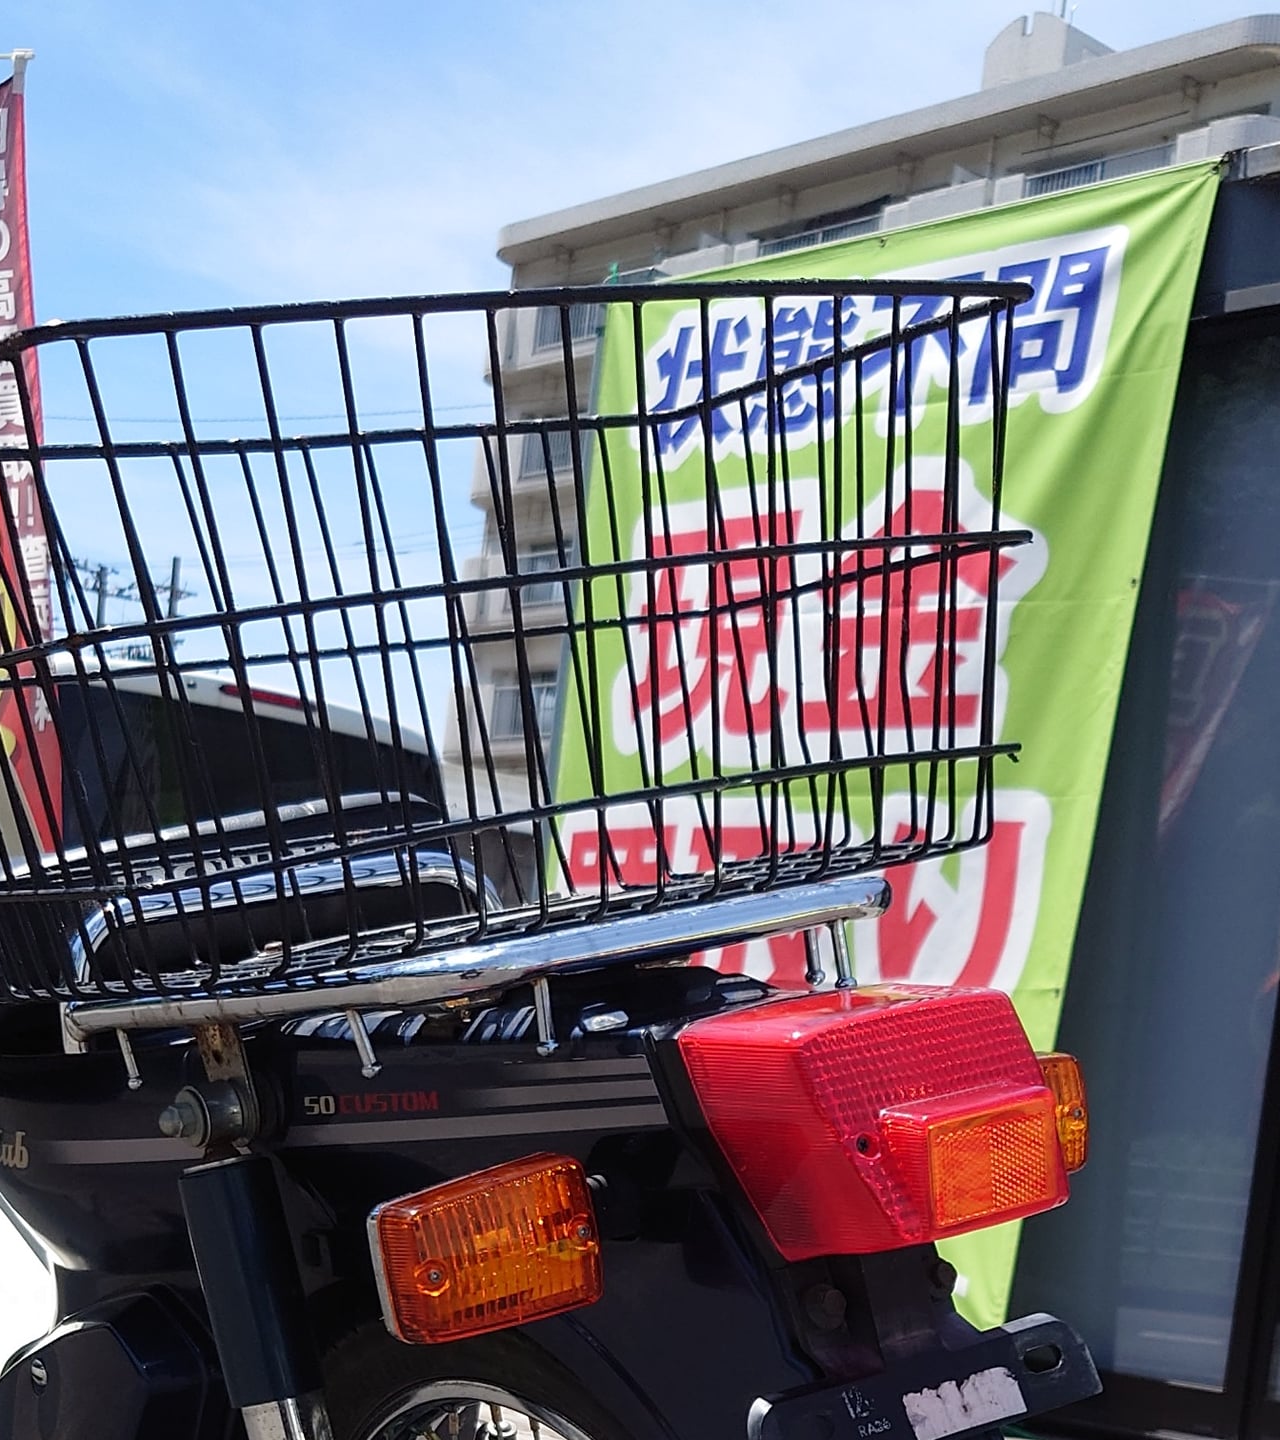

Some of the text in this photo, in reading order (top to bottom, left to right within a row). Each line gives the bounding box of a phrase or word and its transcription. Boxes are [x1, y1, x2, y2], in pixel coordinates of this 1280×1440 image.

[648, 244, 1116, 457] 状態不問
[631, 486, 1016, 742] 現金
[303, 1089, 440, 1116] 50 CUSTOM
